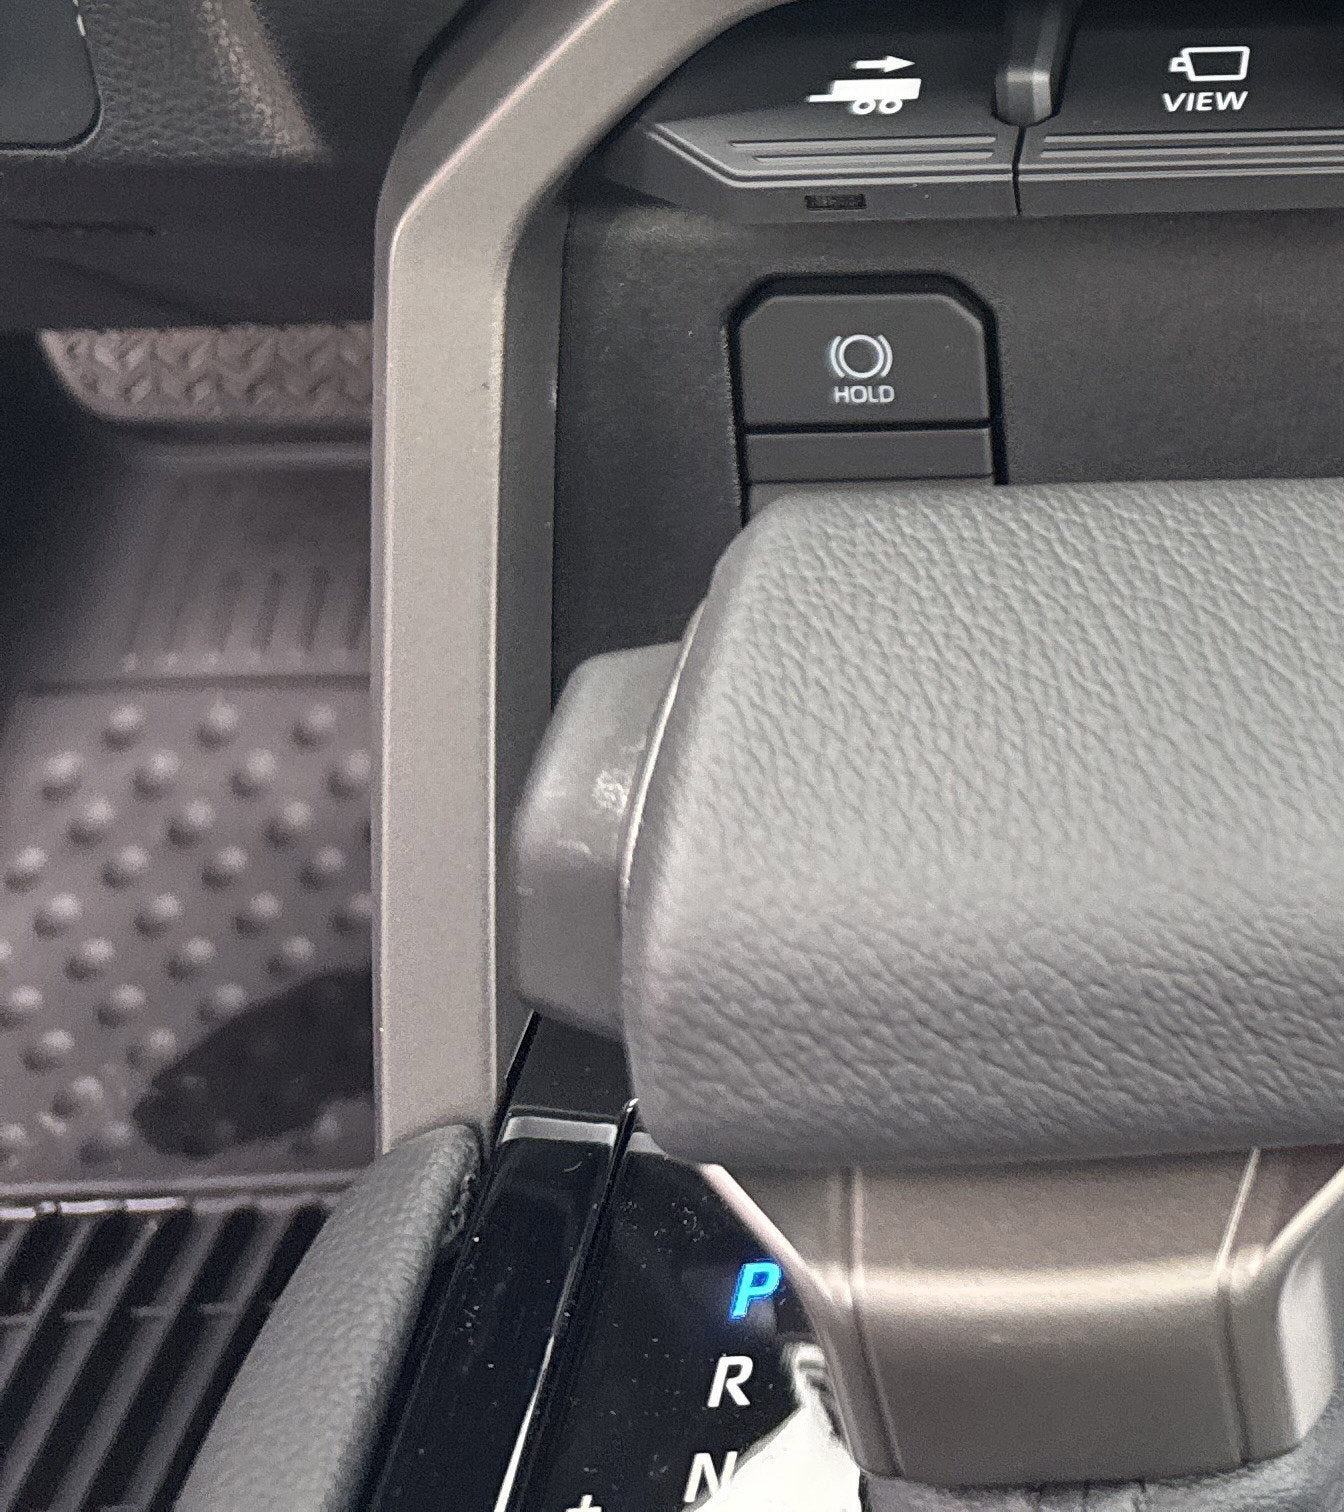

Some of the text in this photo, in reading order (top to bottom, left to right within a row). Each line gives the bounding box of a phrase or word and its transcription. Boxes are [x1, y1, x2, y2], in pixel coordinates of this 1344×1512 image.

[1162, 90, 1248, 112] VIEW
[832, 385, 895, 403] HOLD
[728, 1258, 783, 1320] P
[707, 1355, 754, 1408] R
[683, 1450, 739, 1503] N
